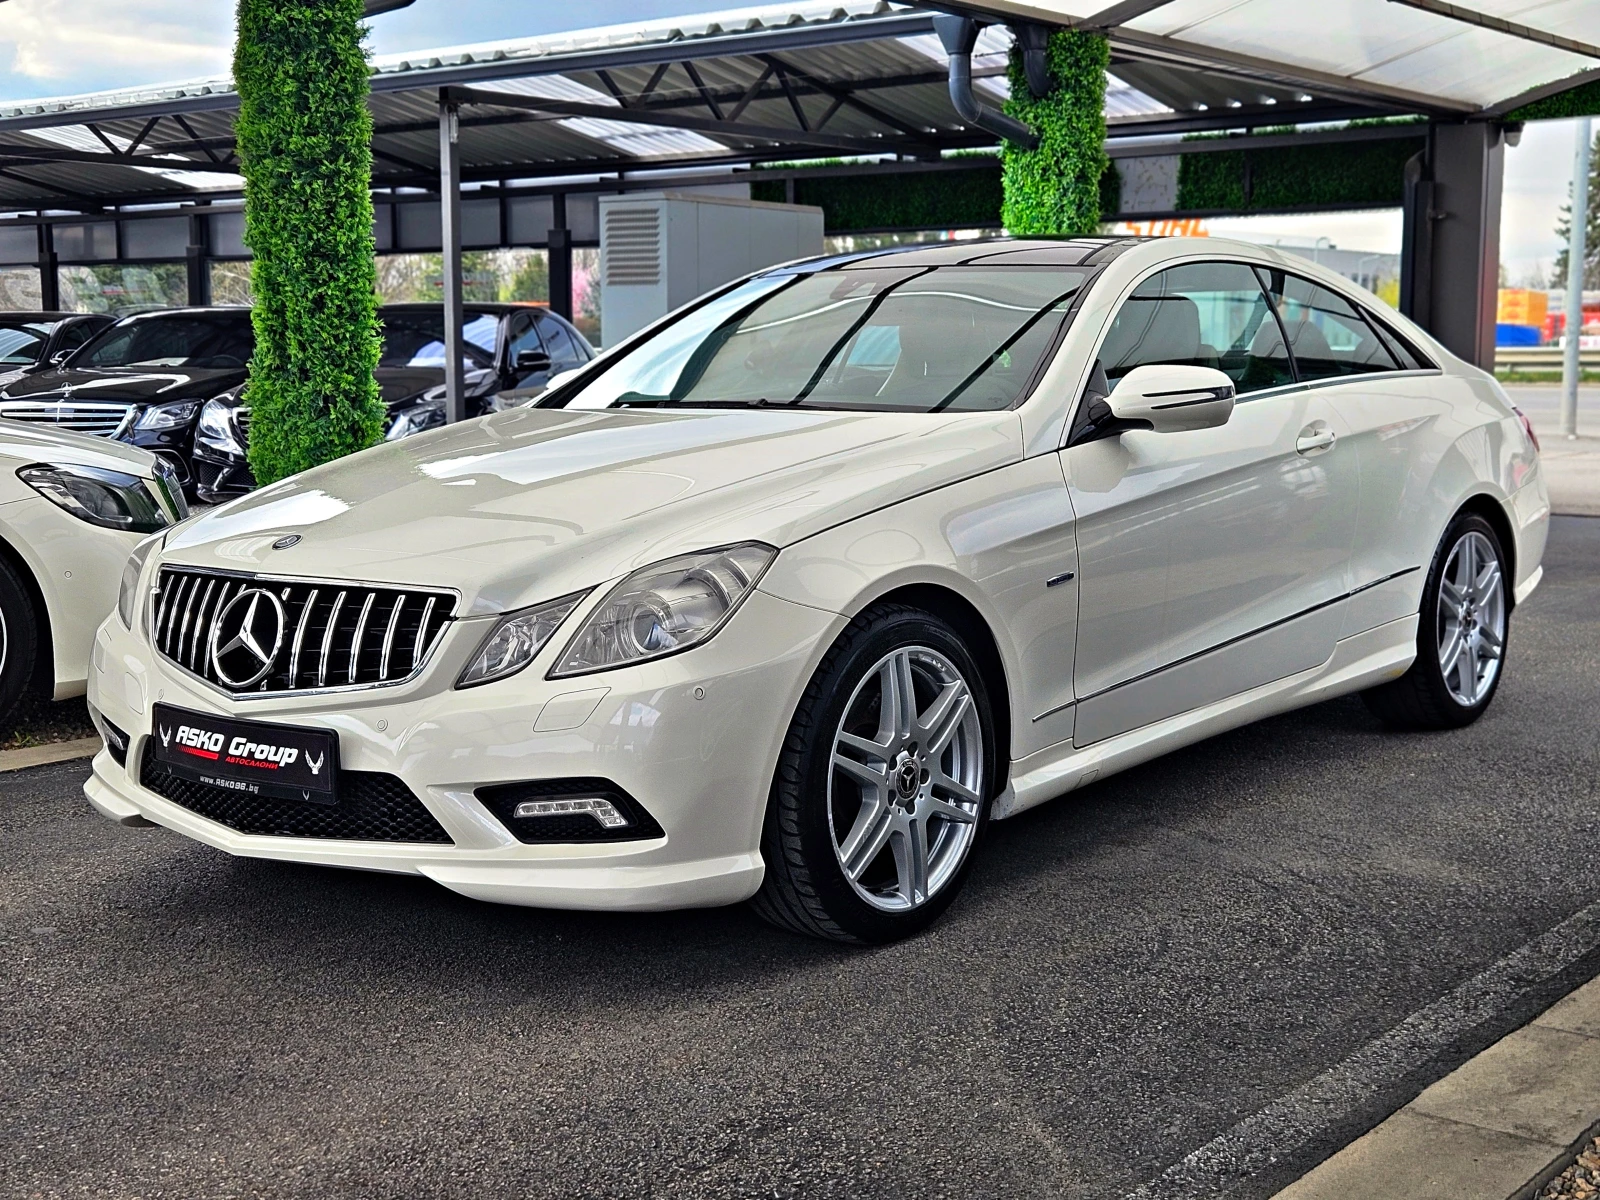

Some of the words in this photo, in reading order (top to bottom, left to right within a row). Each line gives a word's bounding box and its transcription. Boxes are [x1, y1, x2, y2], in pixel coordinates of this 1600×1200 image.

[175, 725, 225, 752] ASKO
[228, 737, 299, 767] Group
[225, 756, 279, 770] АВТОСАЛОНИ
